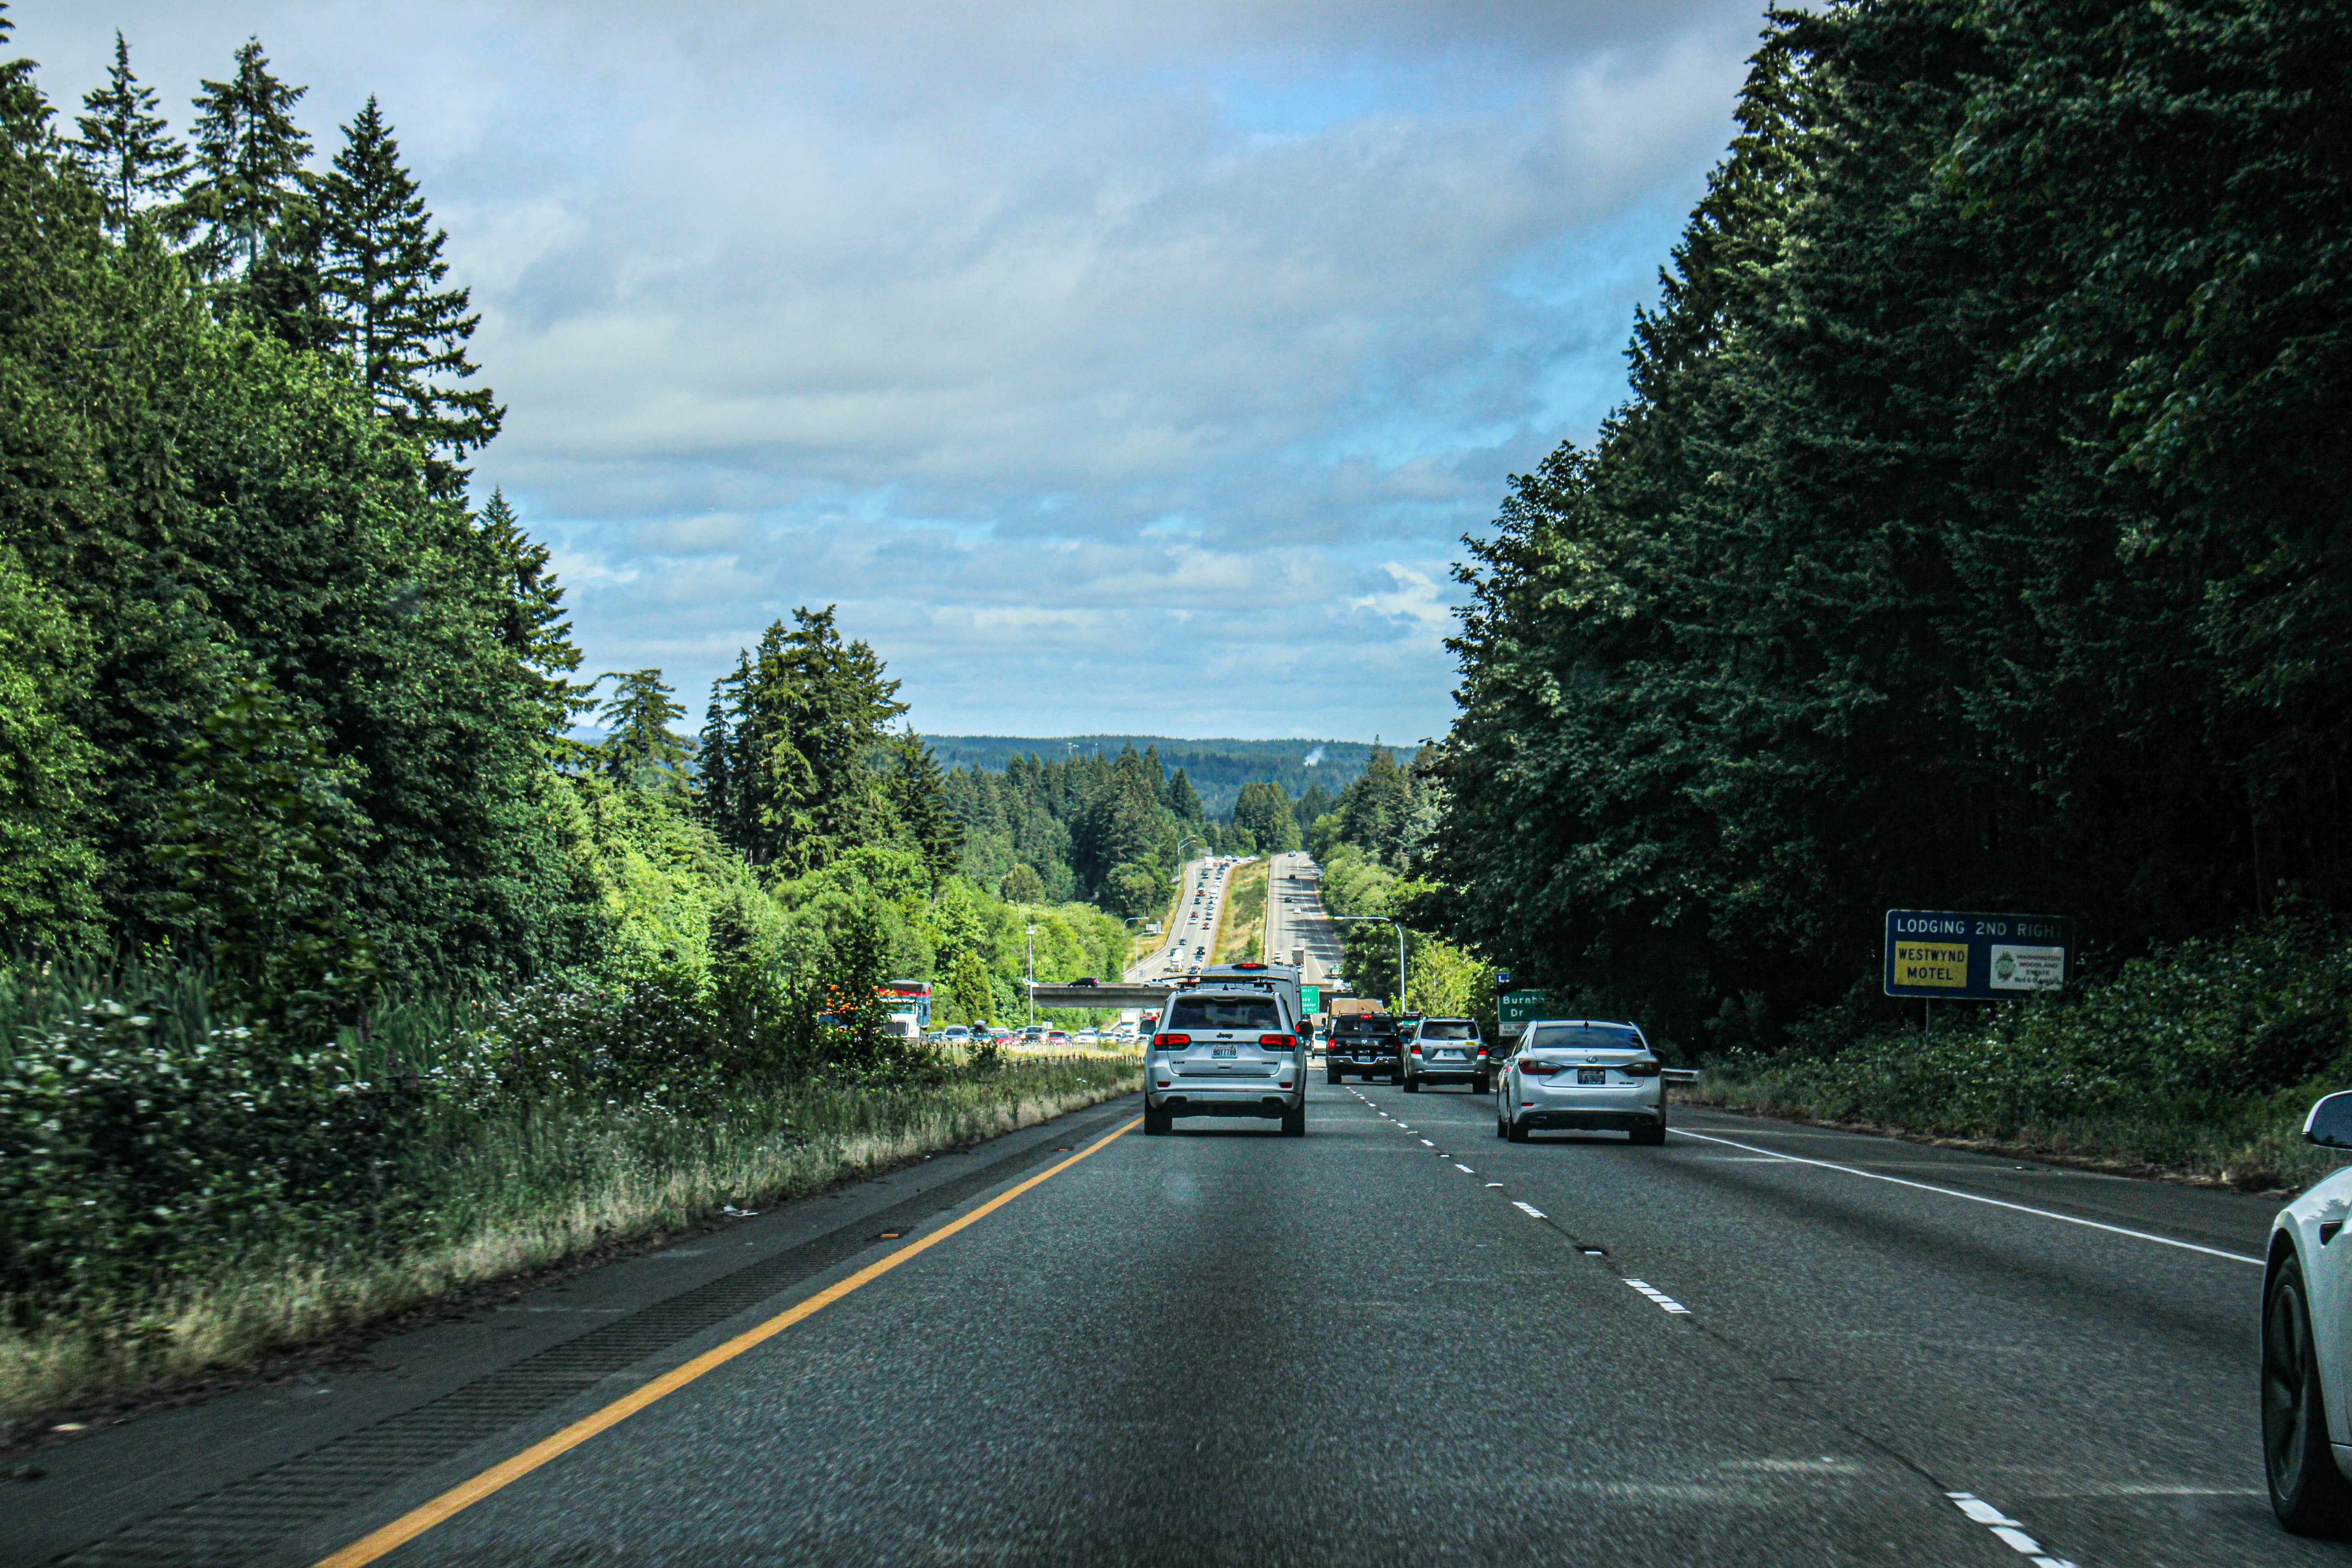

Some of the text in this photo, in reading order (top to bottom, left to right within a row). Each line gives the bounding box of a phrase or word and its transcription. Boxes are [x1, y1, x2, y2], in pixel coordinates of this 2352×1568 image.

[1897, 919, 1964, 934] LODGING
[1976, 922, 2007, 935] 2ND
[1898, 948, 1965, 962] WESTWYND
[1907, 967, 1953, 980] MOTEL
[1511, 1008, 1523, 1017] Dr
